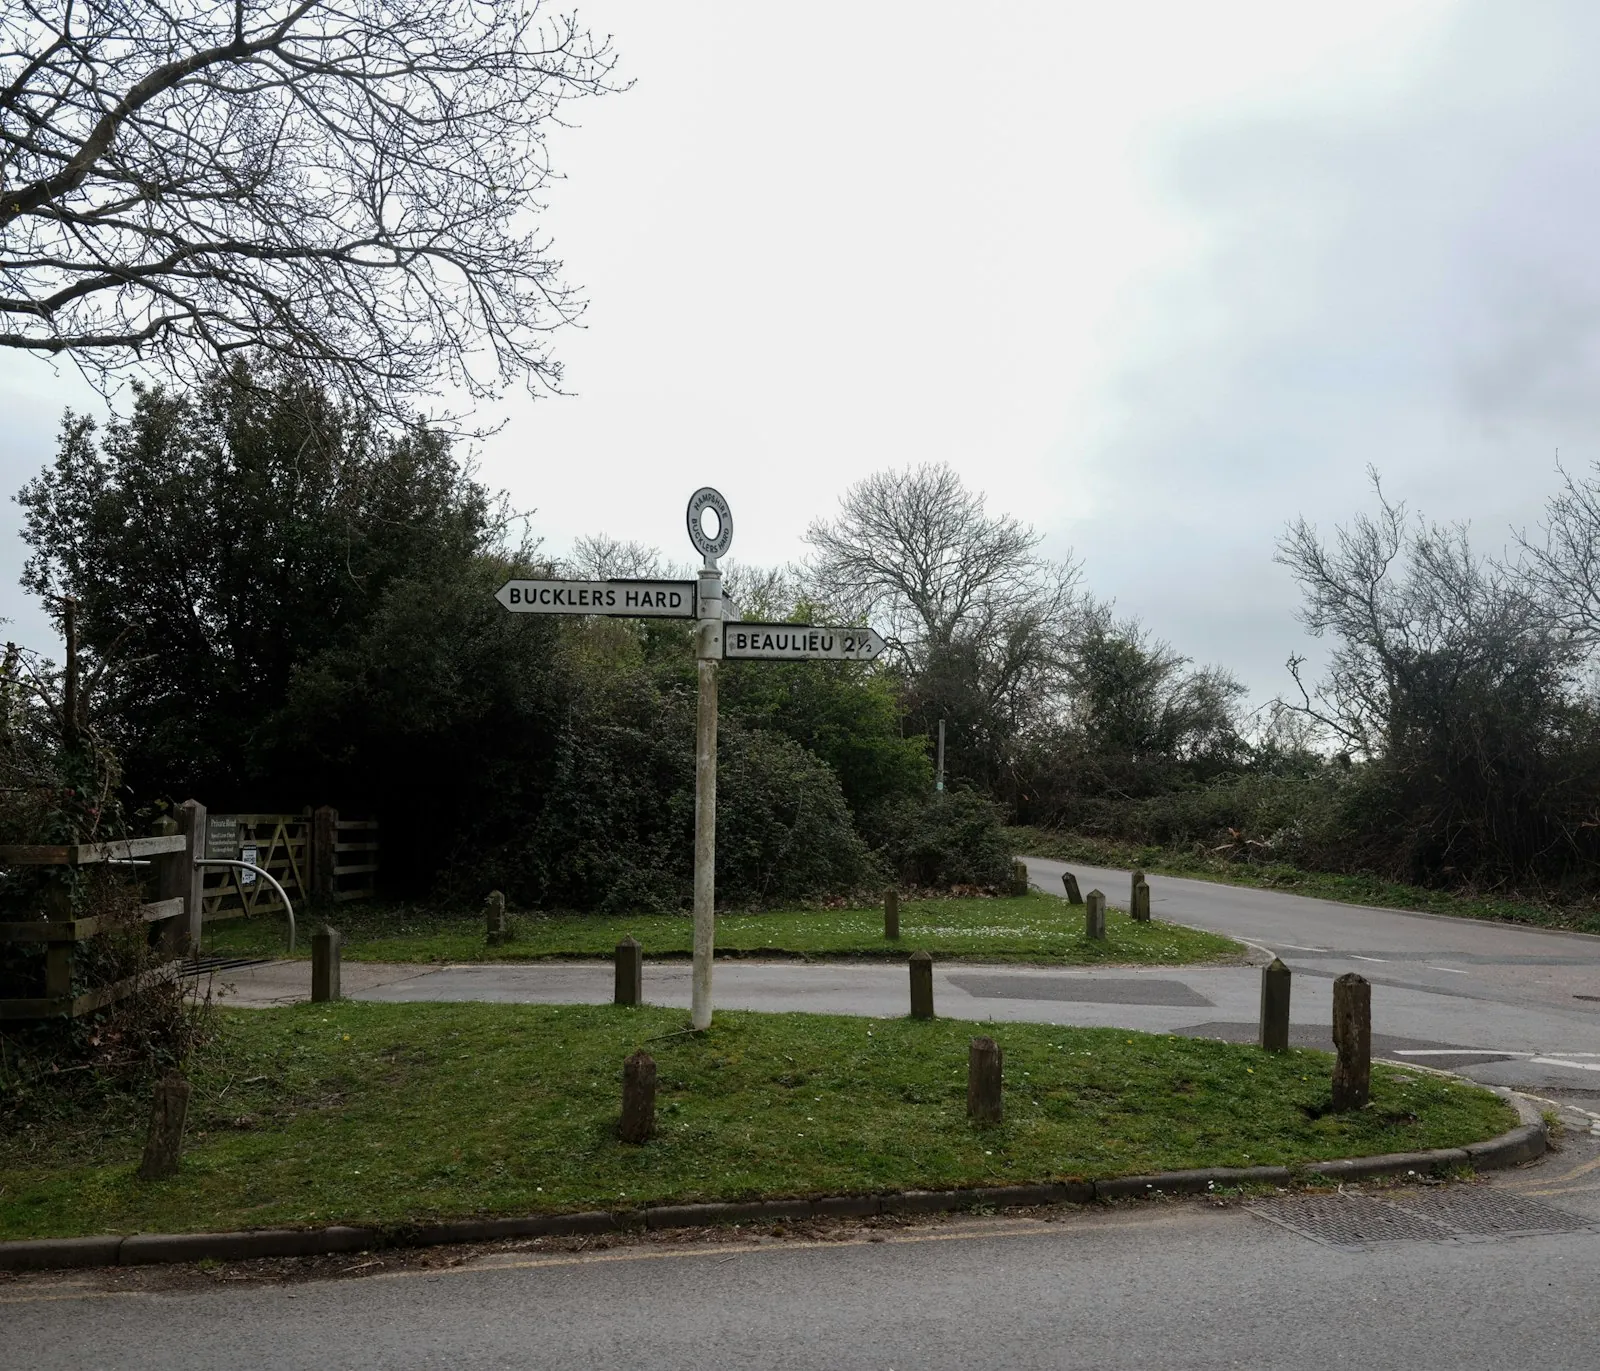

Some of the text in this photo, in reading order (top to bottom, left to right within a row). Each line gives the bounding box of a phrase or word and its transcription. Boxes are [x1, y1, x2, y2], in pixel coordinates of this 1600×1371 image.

[694, 493, 728, 518] HAMPSHIRE
[692, 519, 729, 552] BUCKLERS HARD
[510, 588, 682, 608] BUCKLERS HARD
[736, 633, 834, 652] BEAULIEU
